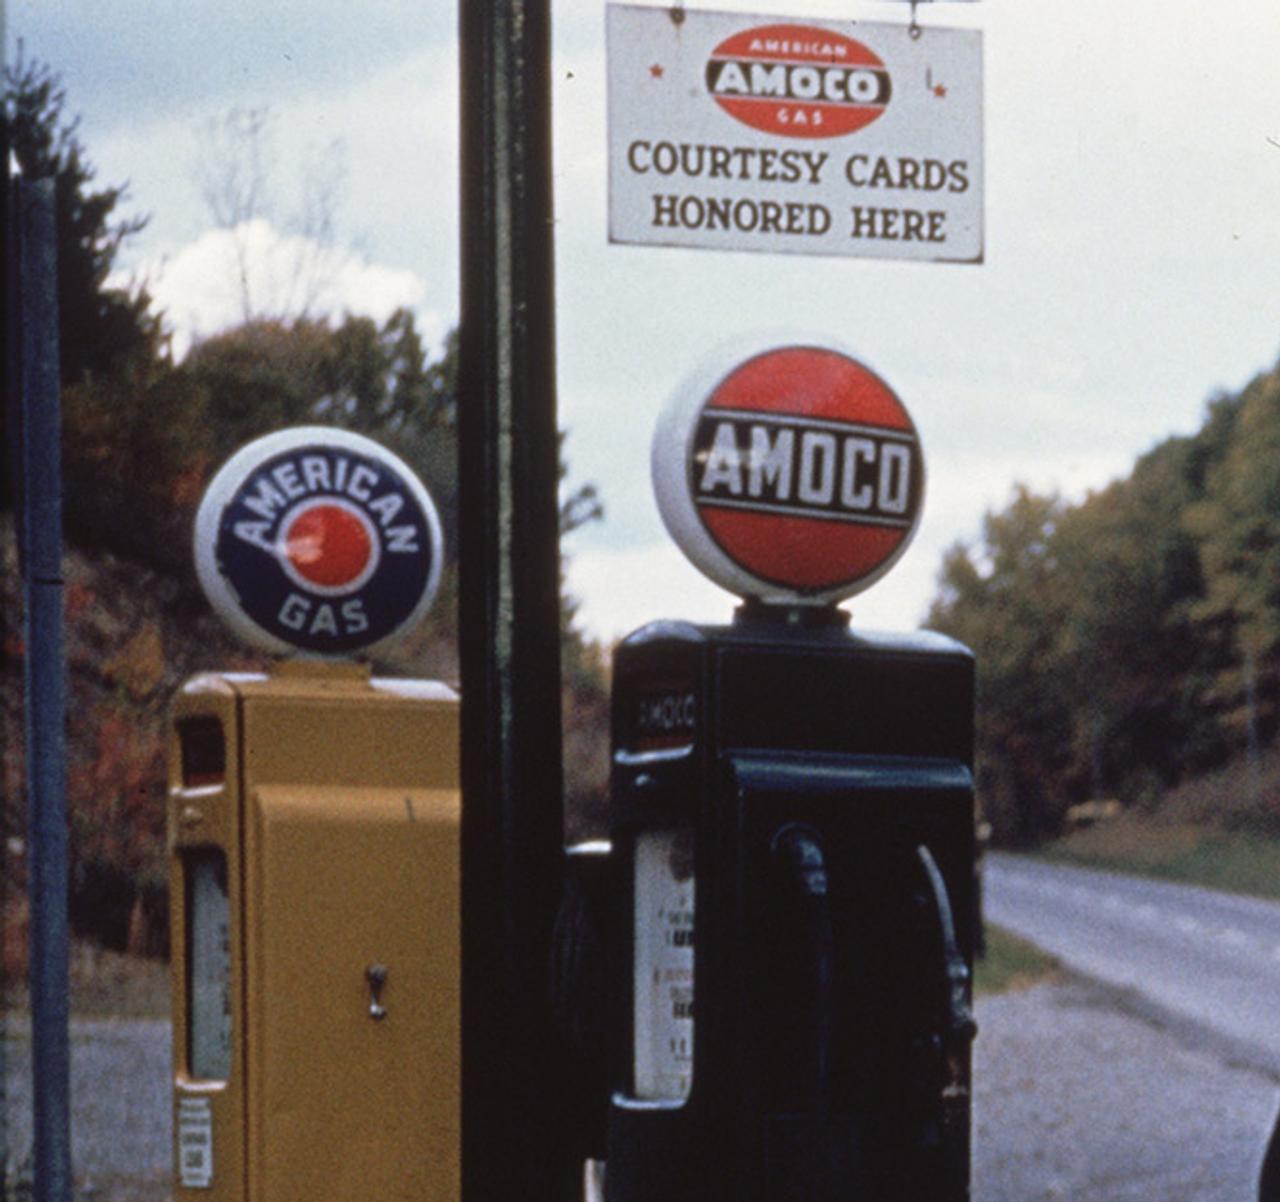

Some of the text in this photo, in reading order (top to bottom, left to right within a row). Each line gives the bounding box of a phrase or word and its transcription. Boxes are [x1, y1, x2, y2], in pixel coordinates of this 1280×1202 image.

[748, 37, 848, 59] AMERICAN
[714, 62, 881, 102] AMOCO
[776, 108, 824, 127] GAS
[627, 140, 970, 194] COURTESY CARDS
[651, 194, 947, 243] HONORED HERE
[700, 421, 912, 514] AMOCO
[233, 455, 419, 554] AMERICAN
[277, 592, 369, 637] GAS
